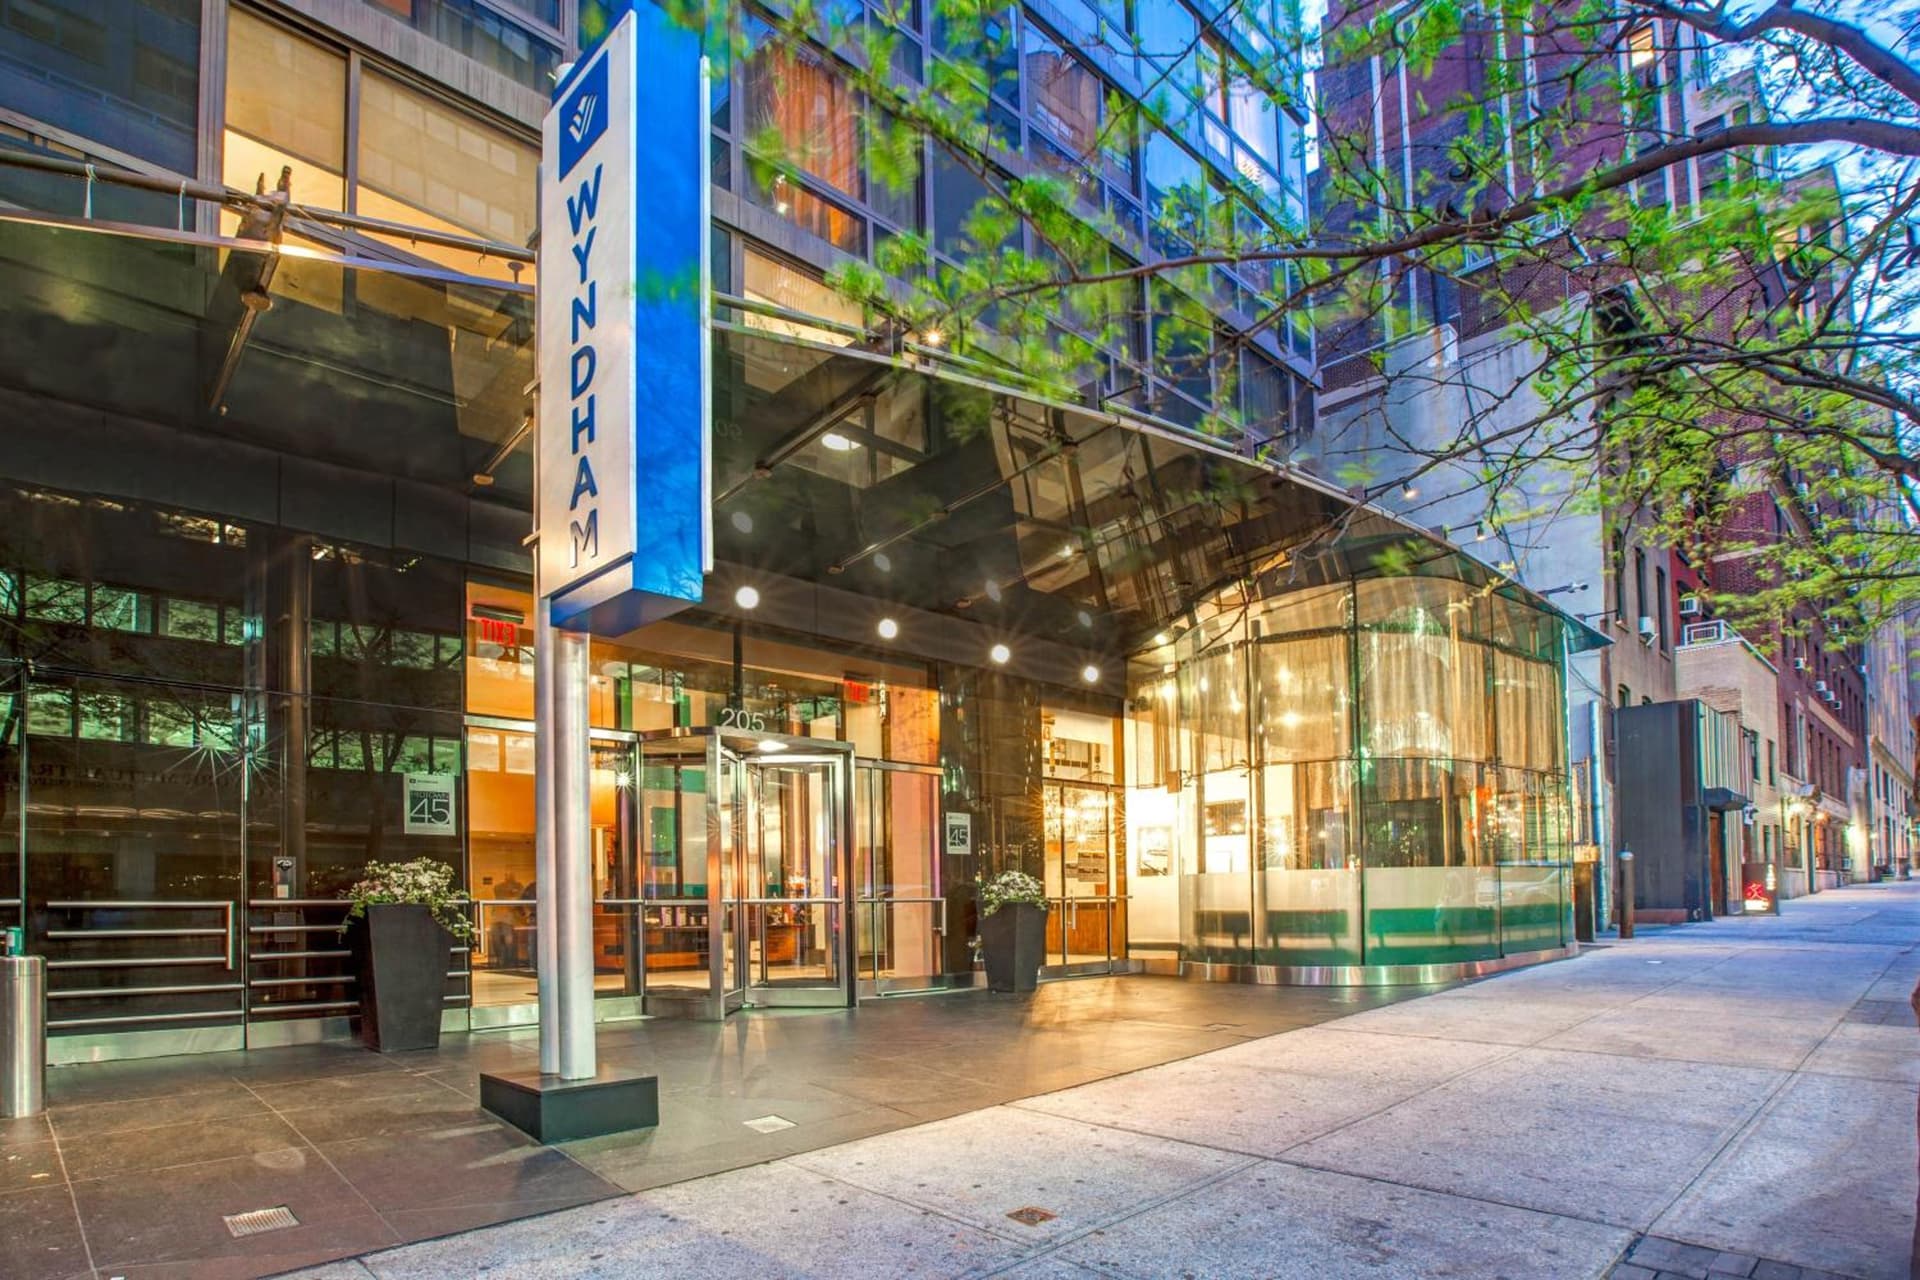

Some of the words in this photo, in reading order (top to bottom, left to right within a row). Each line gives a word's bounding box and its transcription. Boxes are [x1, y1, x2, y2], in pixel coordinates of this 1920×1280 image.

[566, 162, 603, 569] WYNDHAM
[721, 707, 766, 732] 205
[410, 798, 450, 825] 45
[949, 828, 969, 848] 45
